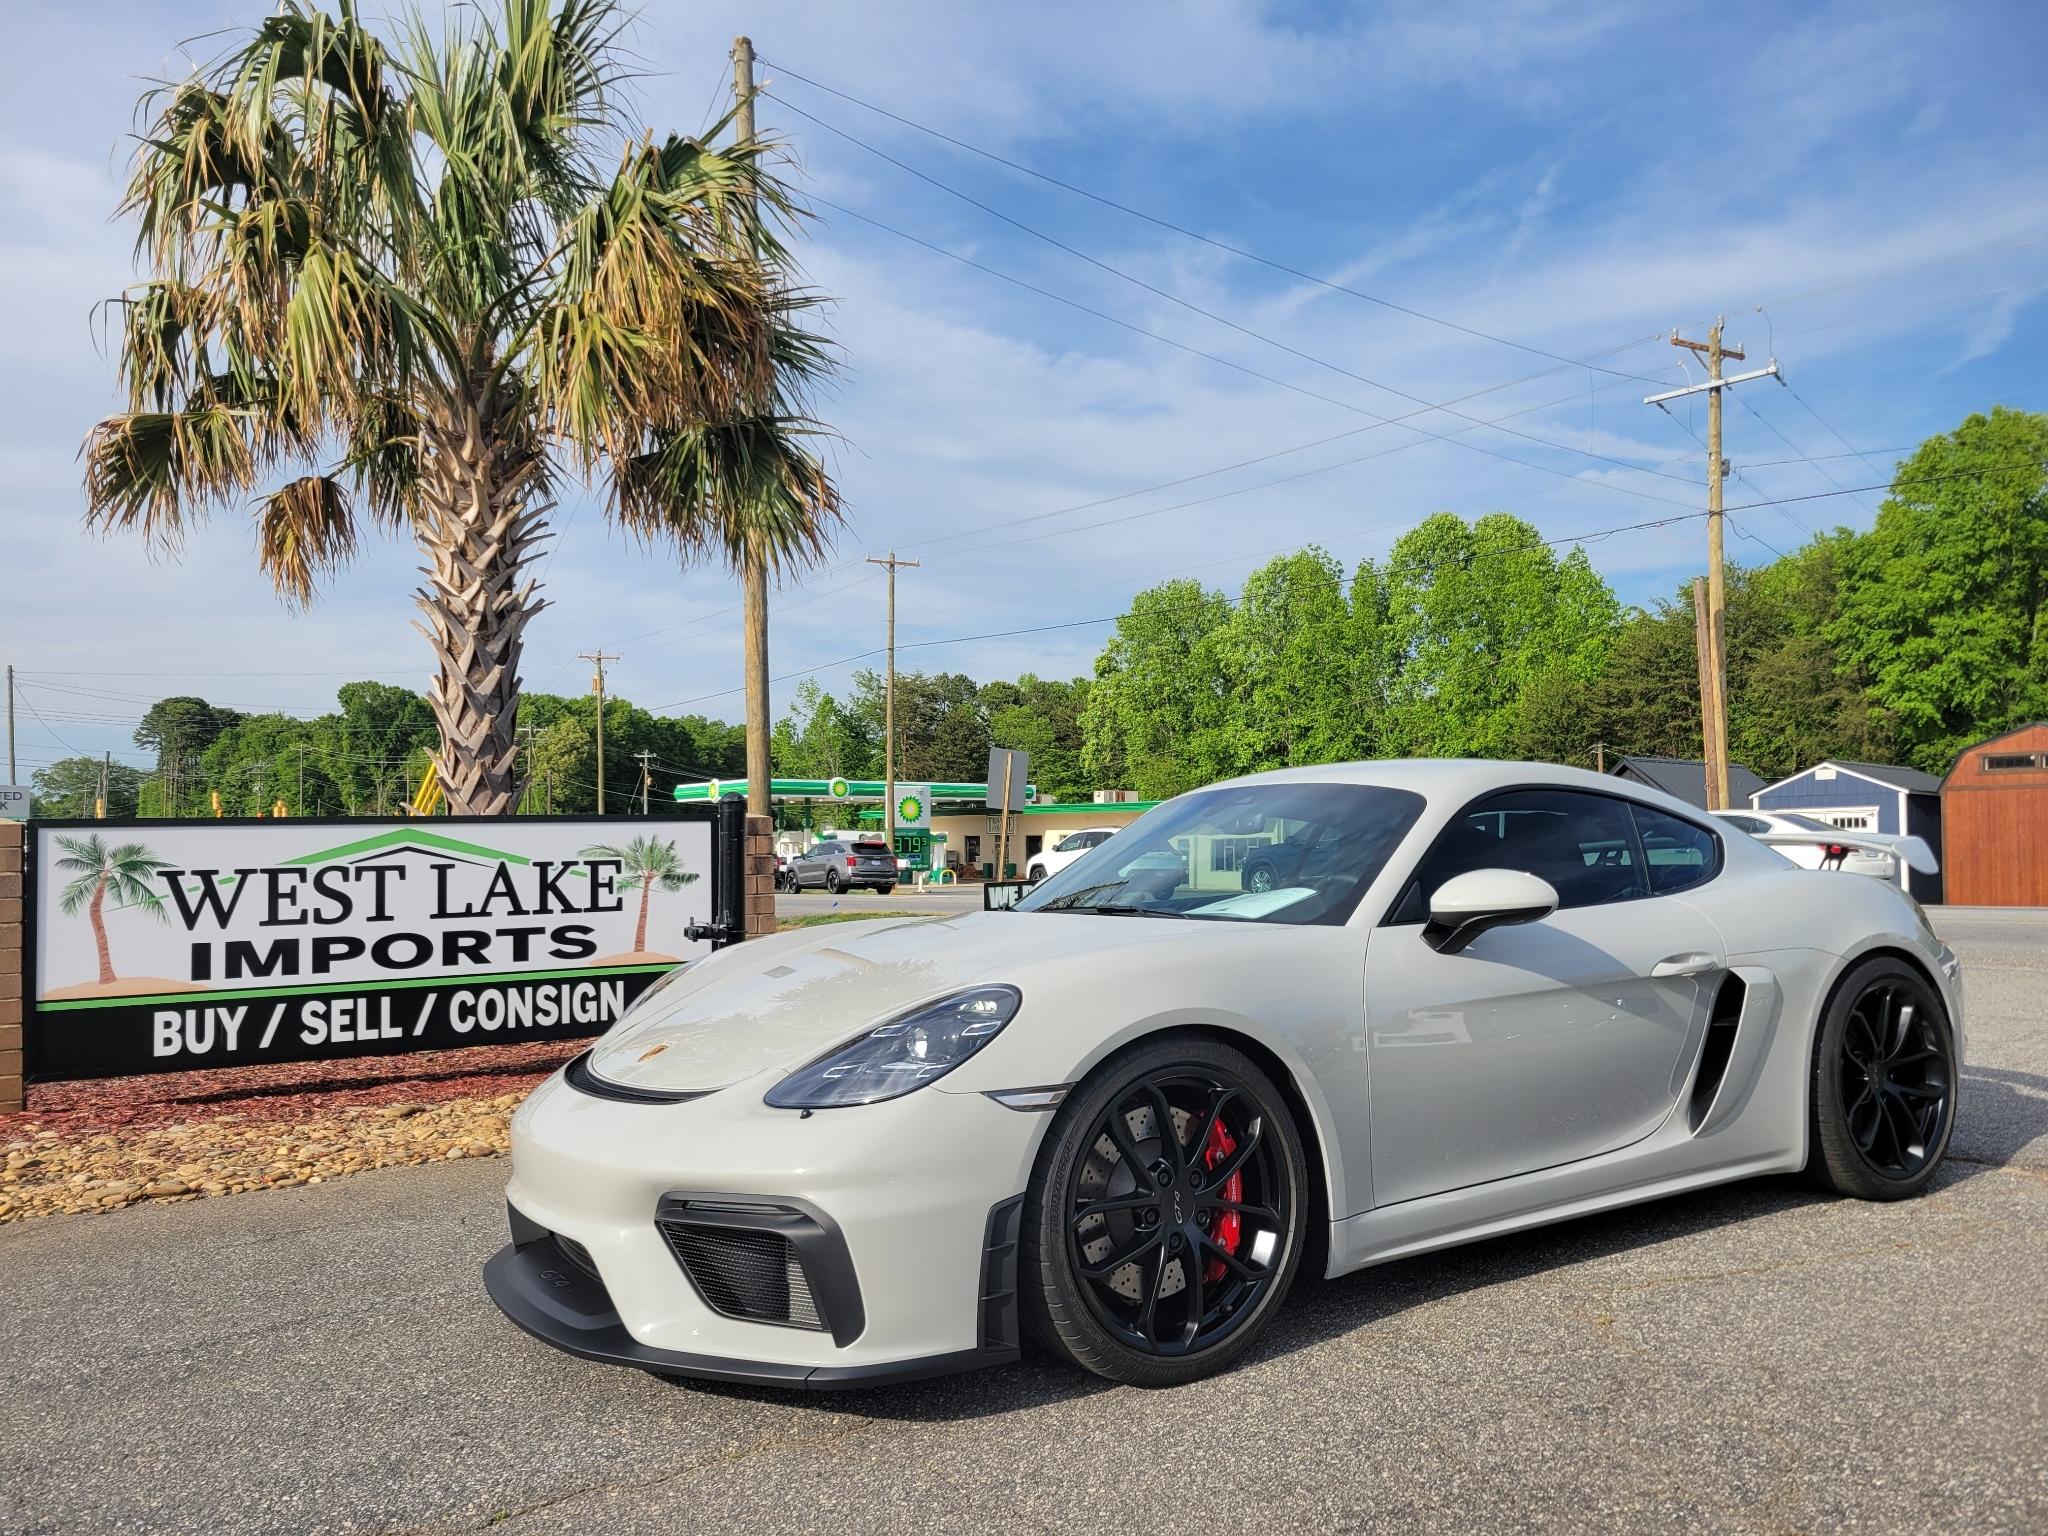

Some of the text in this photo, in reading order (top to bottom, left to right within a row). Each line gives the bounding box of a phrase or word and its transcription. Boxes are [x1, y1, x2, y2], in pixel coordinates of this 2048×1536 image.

[156, 860, 624, 931] WEST LAKE
[191, 924, 598, 981] IMPORTS
[153, 980, 625, 1057] BUY / SELL / CONSIGN
